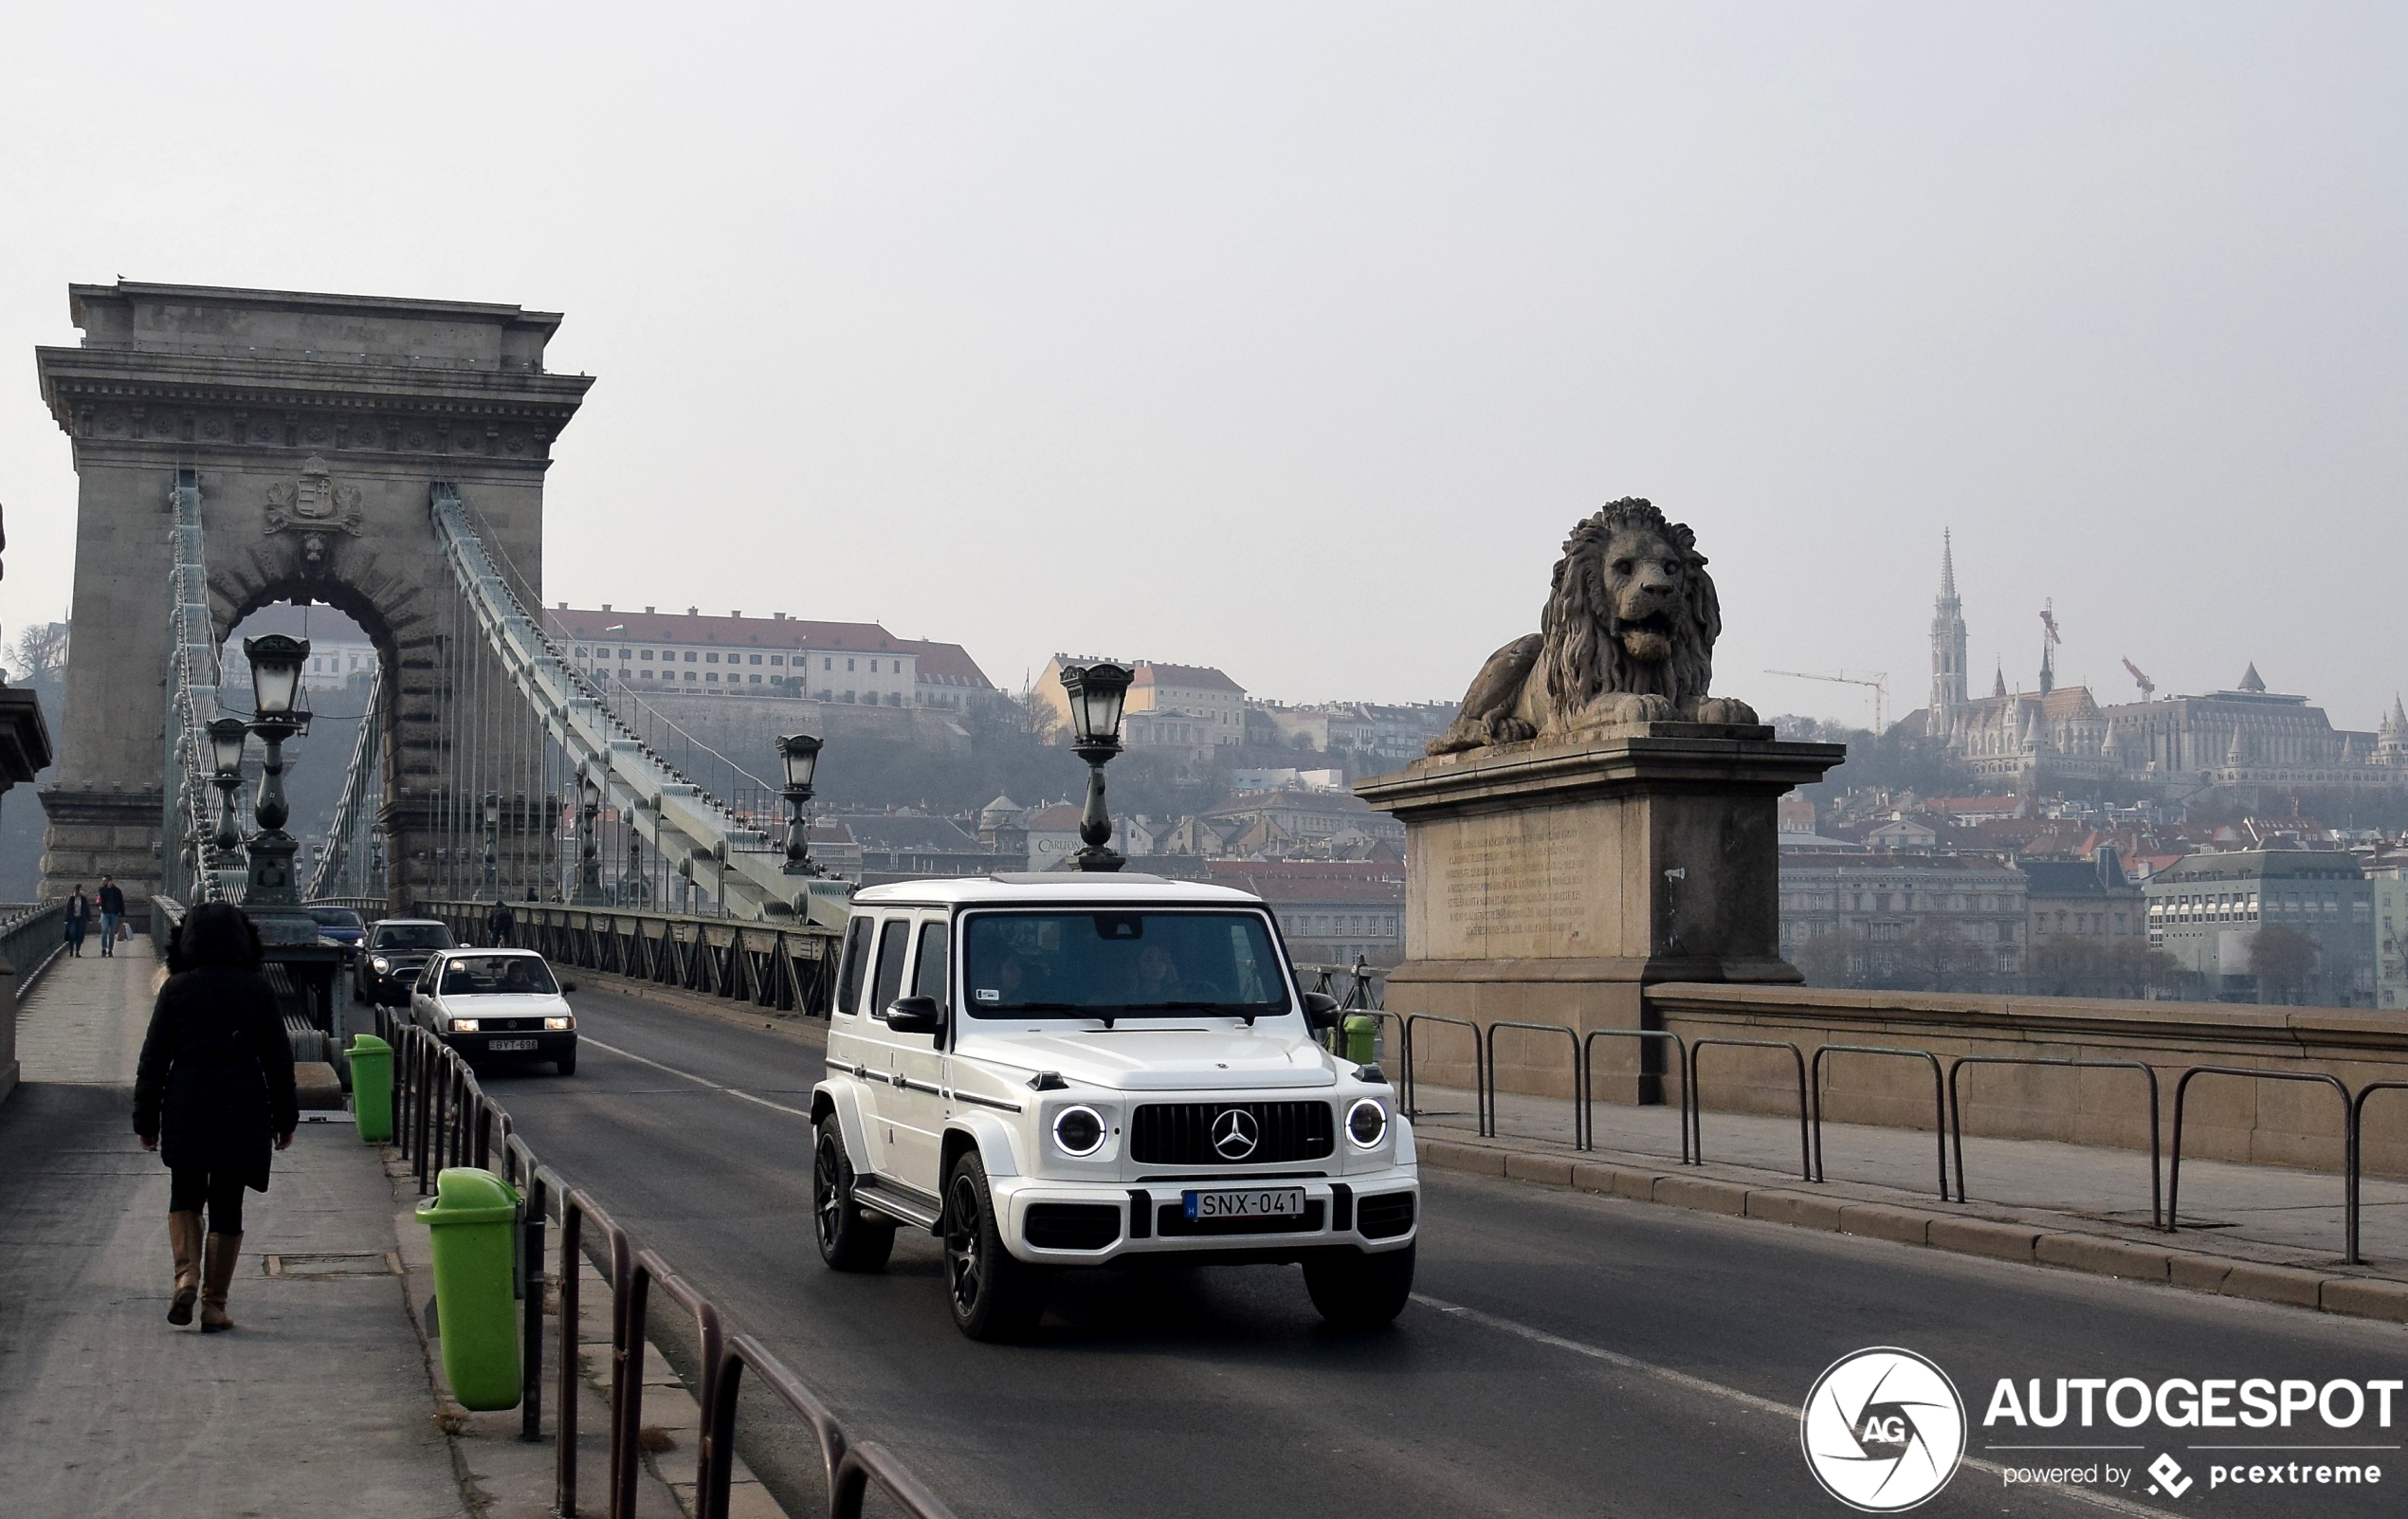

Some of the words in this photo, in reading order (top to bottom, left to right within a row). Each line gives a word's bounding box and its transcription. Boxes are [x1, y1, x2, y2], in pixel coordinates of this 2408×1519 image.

[1038, 839, 1080, 852] CARLTON
[496, 1040, 537, 1050] BYT-696
[1202, 1193, 1297, 1216] SNX-041
